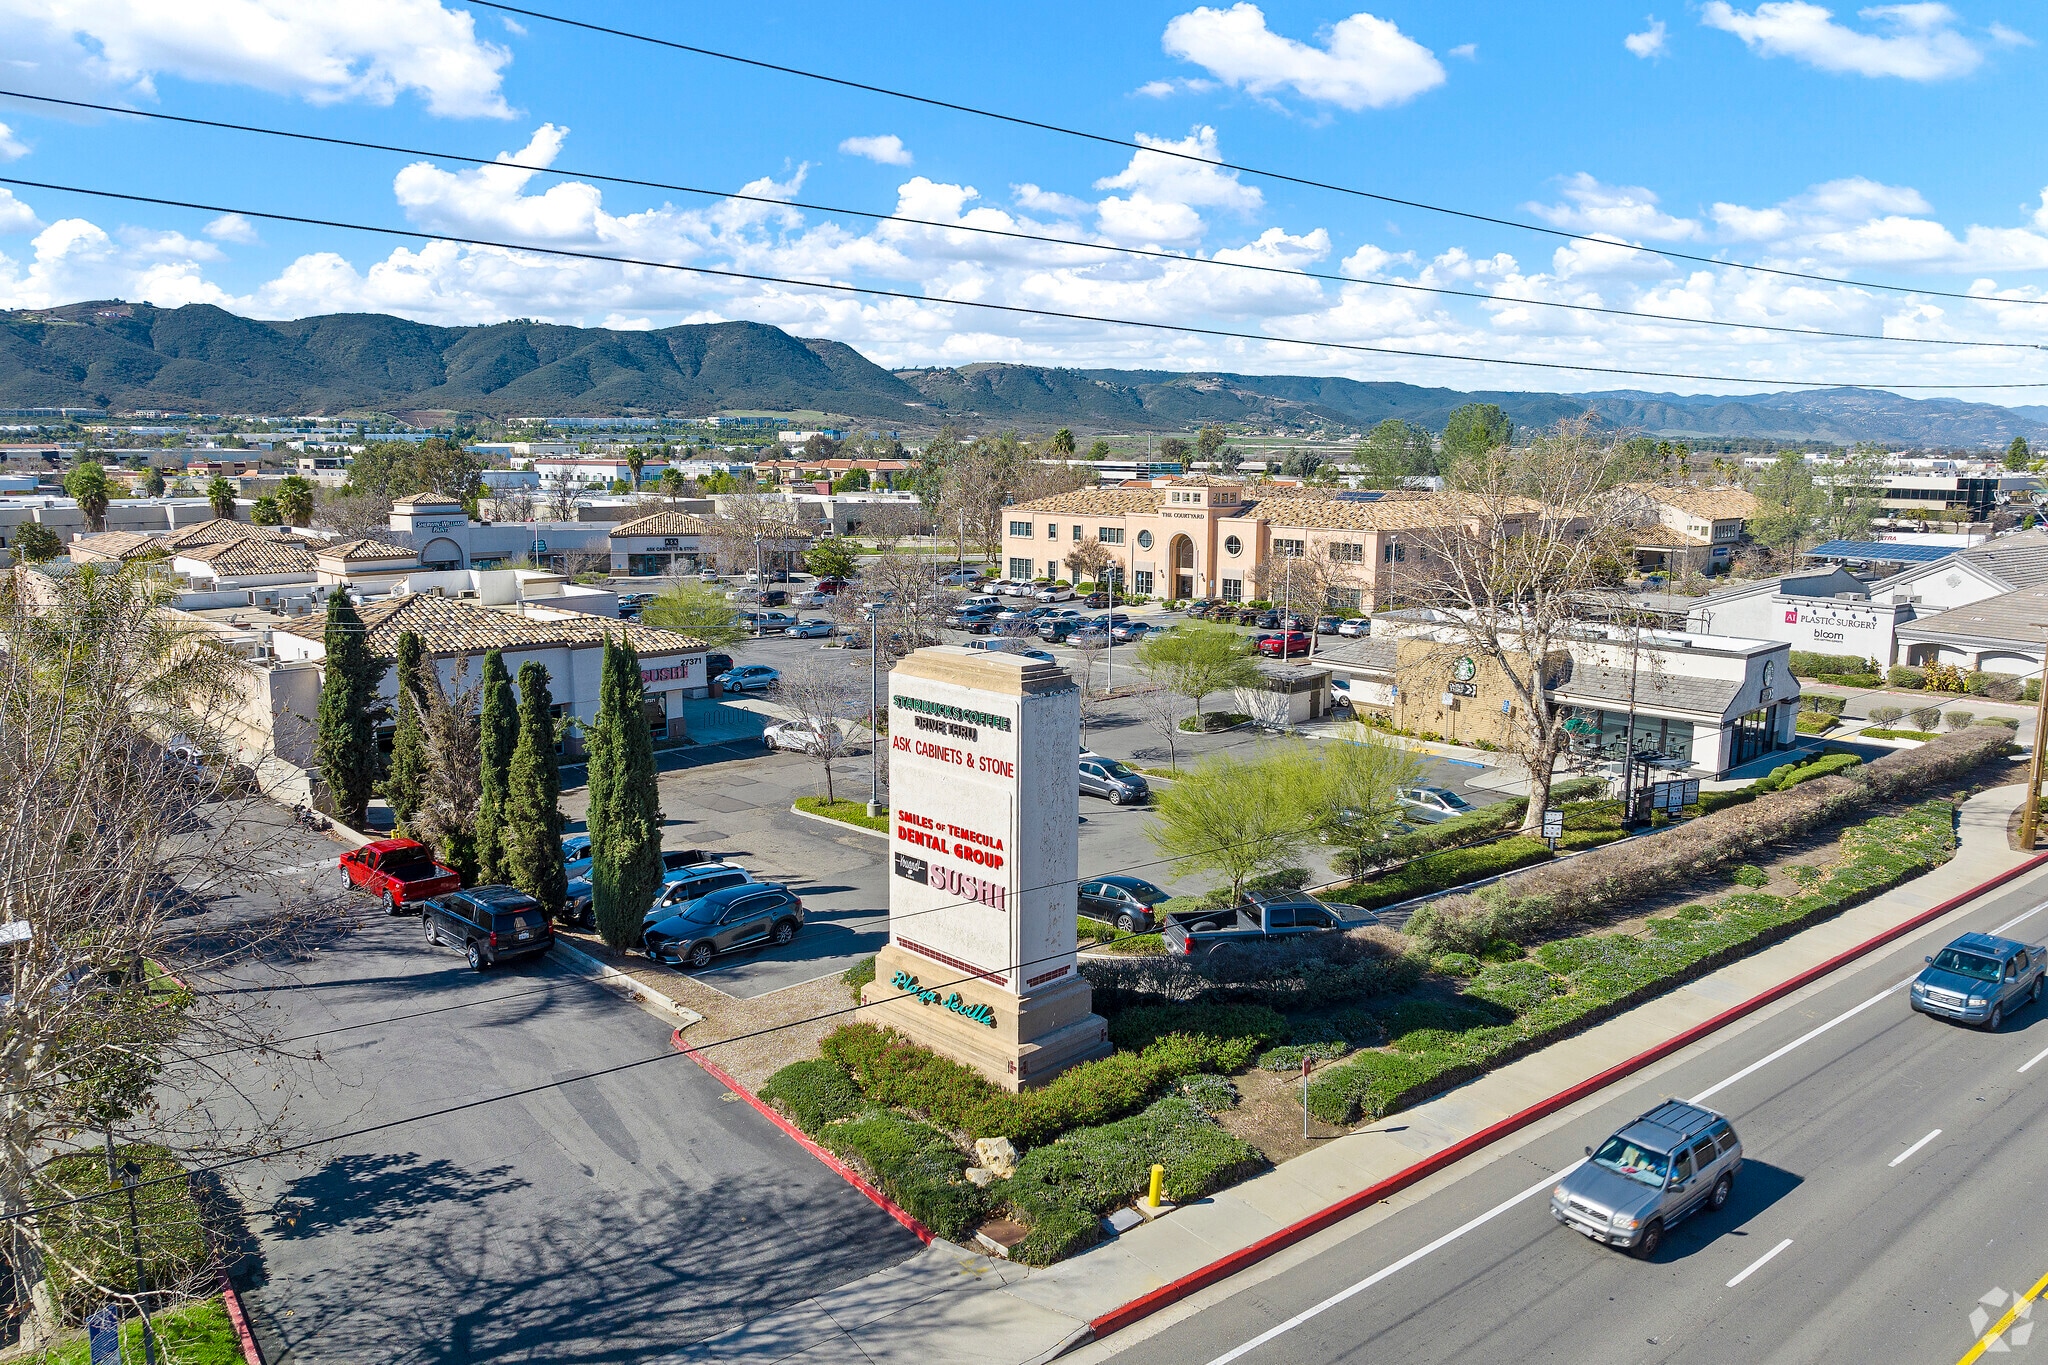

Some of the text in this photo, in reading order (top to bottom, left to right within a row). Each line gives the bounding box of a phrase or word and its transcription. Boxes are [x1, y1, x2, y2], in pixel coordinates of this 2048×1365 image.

[1173, 512, 1205, 520] COURTYARD
[1800, 615, 1835, 626] PLASTIC
[1836, 619, 1877, 630] SURGERY
[1814, 628, 1843, 640] bloom
[641, 666, 688, 684] SUSHI
[680, 657, 702, 666] 27371
[893, 694, 1010, 732] STARBUCKS COFFEE
[915, 716, 978, 742] DRIVE THRU
[892, 735, 1014, 778] ASK CABINETS & STONE
[898, 809, 1004, 851] SMILES OF TEMECULA
[898, 825, 1004, 870] DENTAL GROUP
[930, 863, 1006, 912] SUSHI
[890, 969, 993, 1026] Plaza Seville
